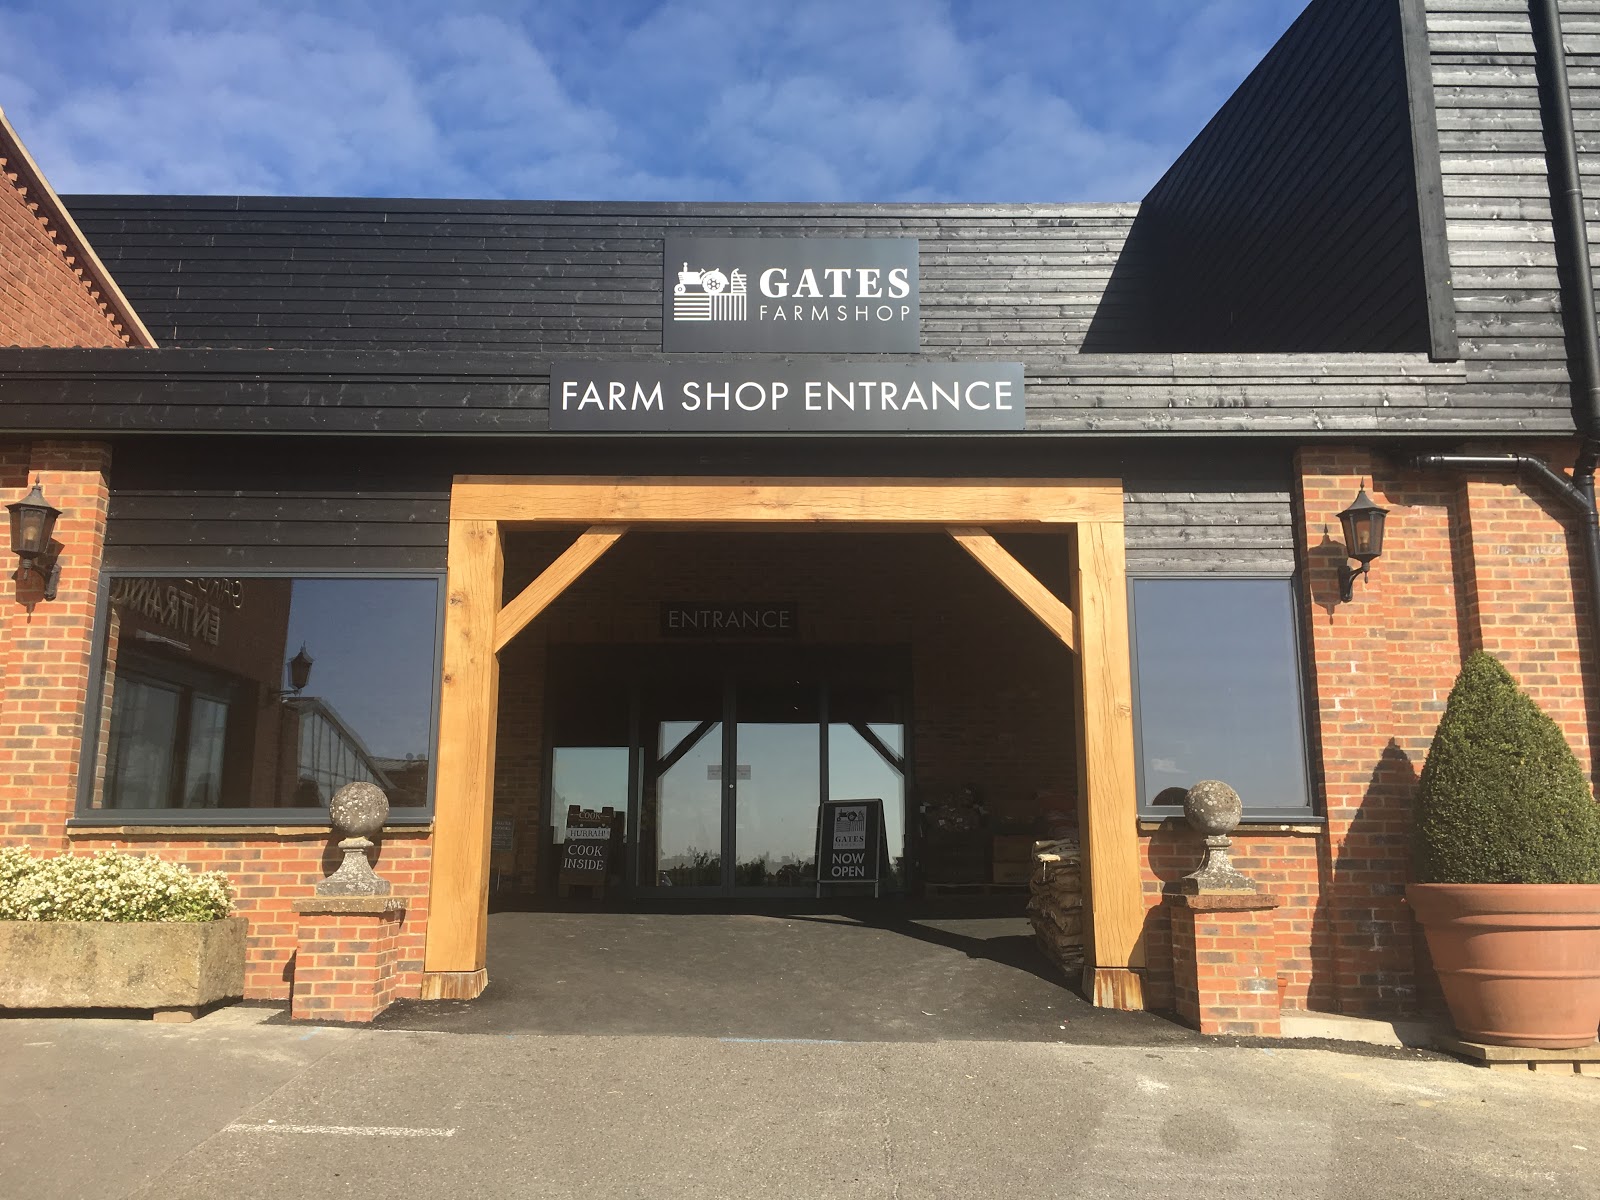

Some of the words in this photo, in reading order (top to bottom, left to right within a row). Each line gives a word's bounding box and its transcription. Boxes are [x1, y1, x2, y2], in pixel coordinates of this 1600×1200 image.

[759, 267, 910, 299] GATES
[759, 305, 910, 321] FARMSHOP
[562, 380, 664, 411] FARM
[681, 380, 789, 411] SHOP
[805, 380, 1013, 411] ENTRANCE
[669, 610, 790, 628] ENTRANCE
[578, 811, 601, 820] COOK
[835, 835, 864, 843] GATES
[567, 844, 604, 857] COOK
[563, 857, 604, 871] INSIDE
[831, 852, 865, 864] NOW
[831, 865, 865, 877] OPEN
